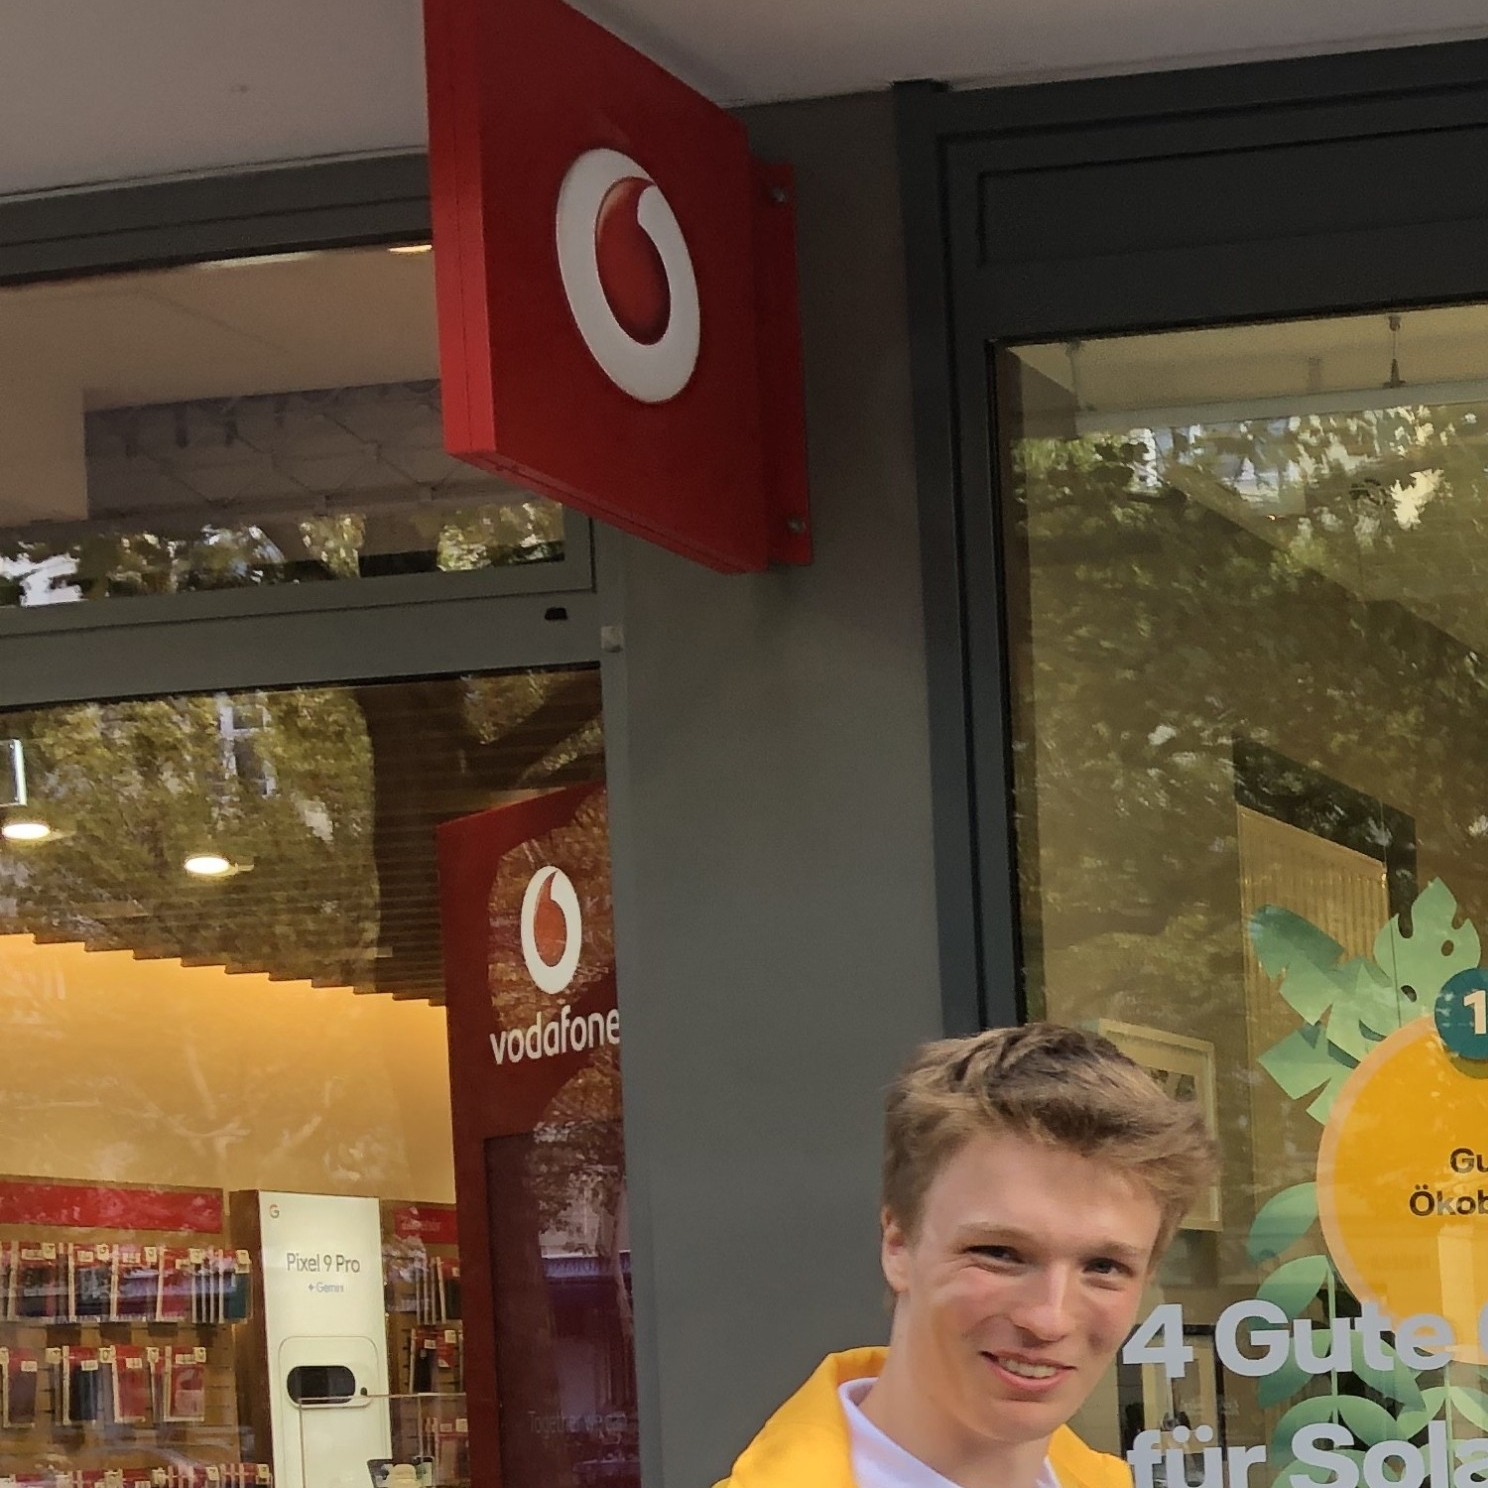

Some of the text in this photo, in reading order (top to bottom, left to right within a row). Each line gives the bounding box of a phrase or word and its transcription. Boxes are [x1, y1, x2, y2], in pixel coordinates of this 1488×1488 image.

[490, 1005, 620, 1065] vodafone
[1463, 990, 1488, 1035] 1
[286, 1253, 361, 1273] Pixel 9 Pro
[1122, 1303, 1195, 1378] 4
[1214, 1298, 1453, 1378] Gute
